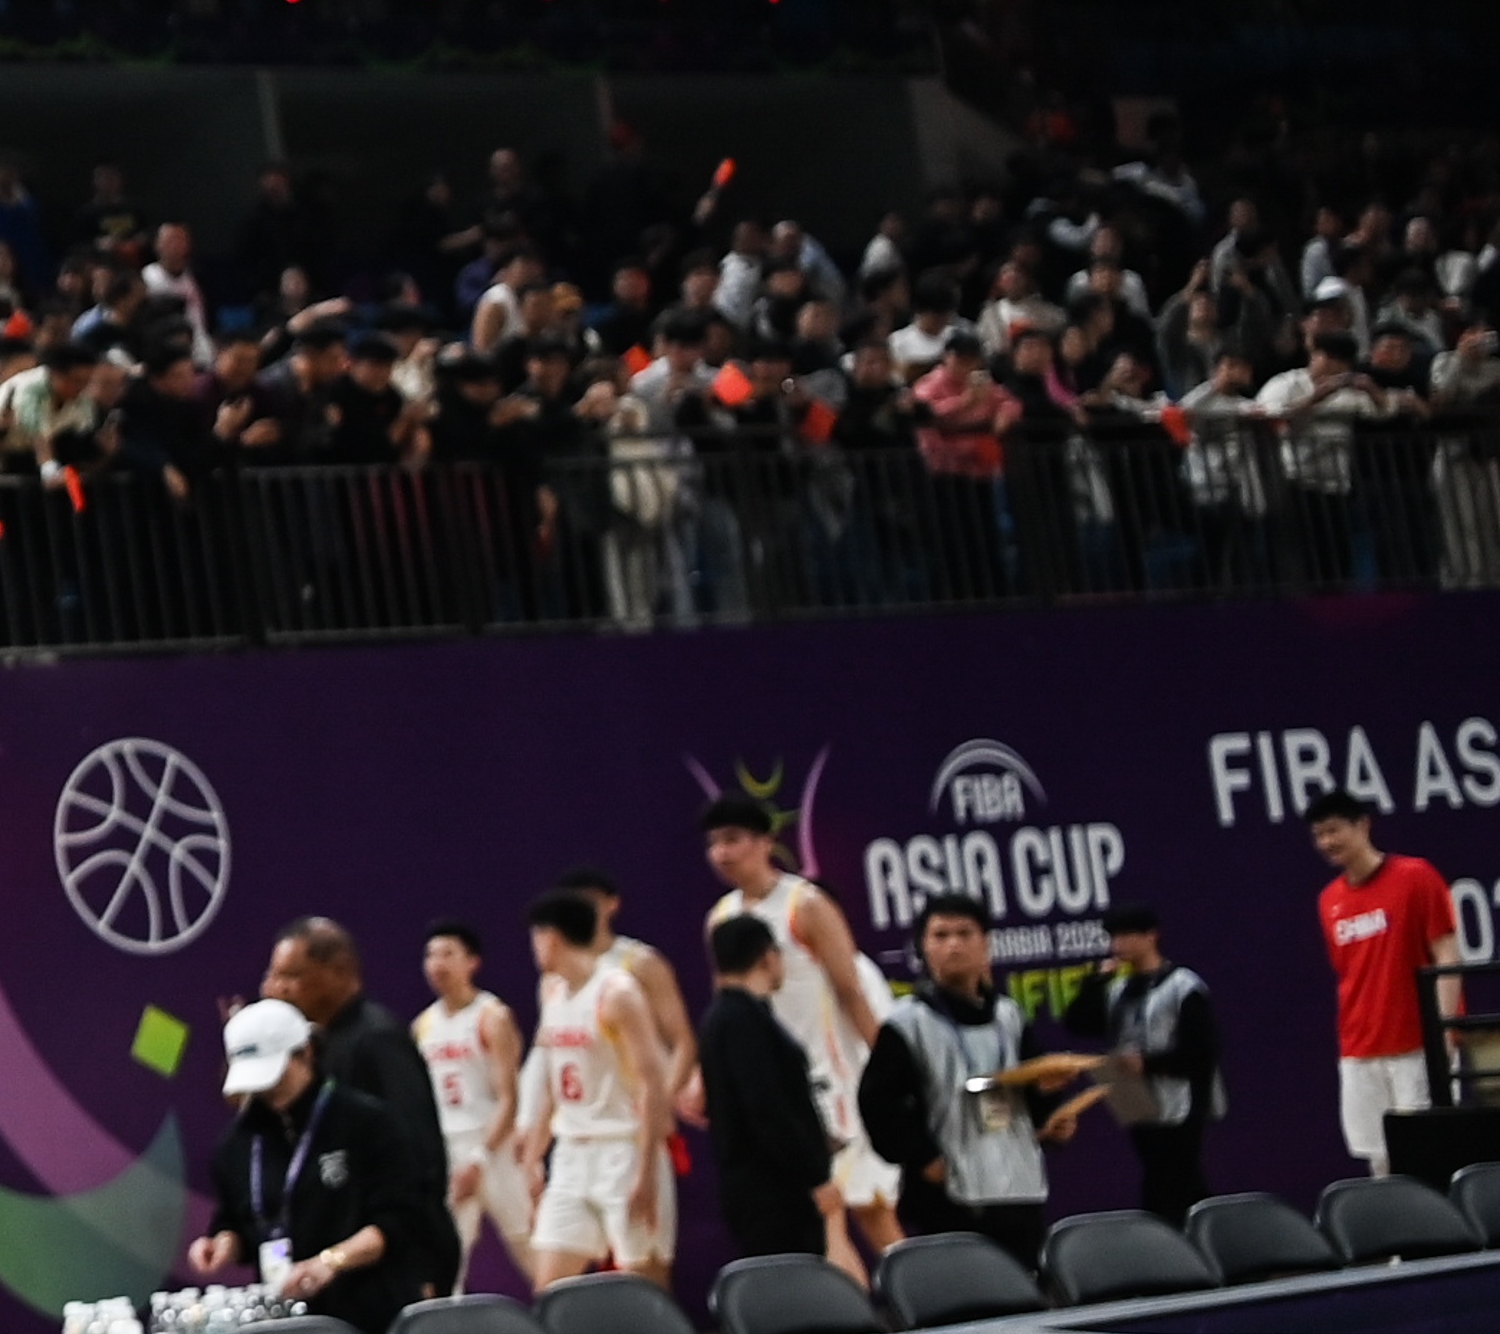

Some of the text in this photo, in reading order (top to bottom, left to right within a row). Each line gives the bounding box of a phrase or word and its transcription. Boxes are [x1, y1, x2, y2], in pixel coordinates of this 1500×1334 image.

[951, 770, 1026, 824] FIBA
[862, 820, 1127, 931] ASIA CUP
[560, 1062, 583, 1103] 6
